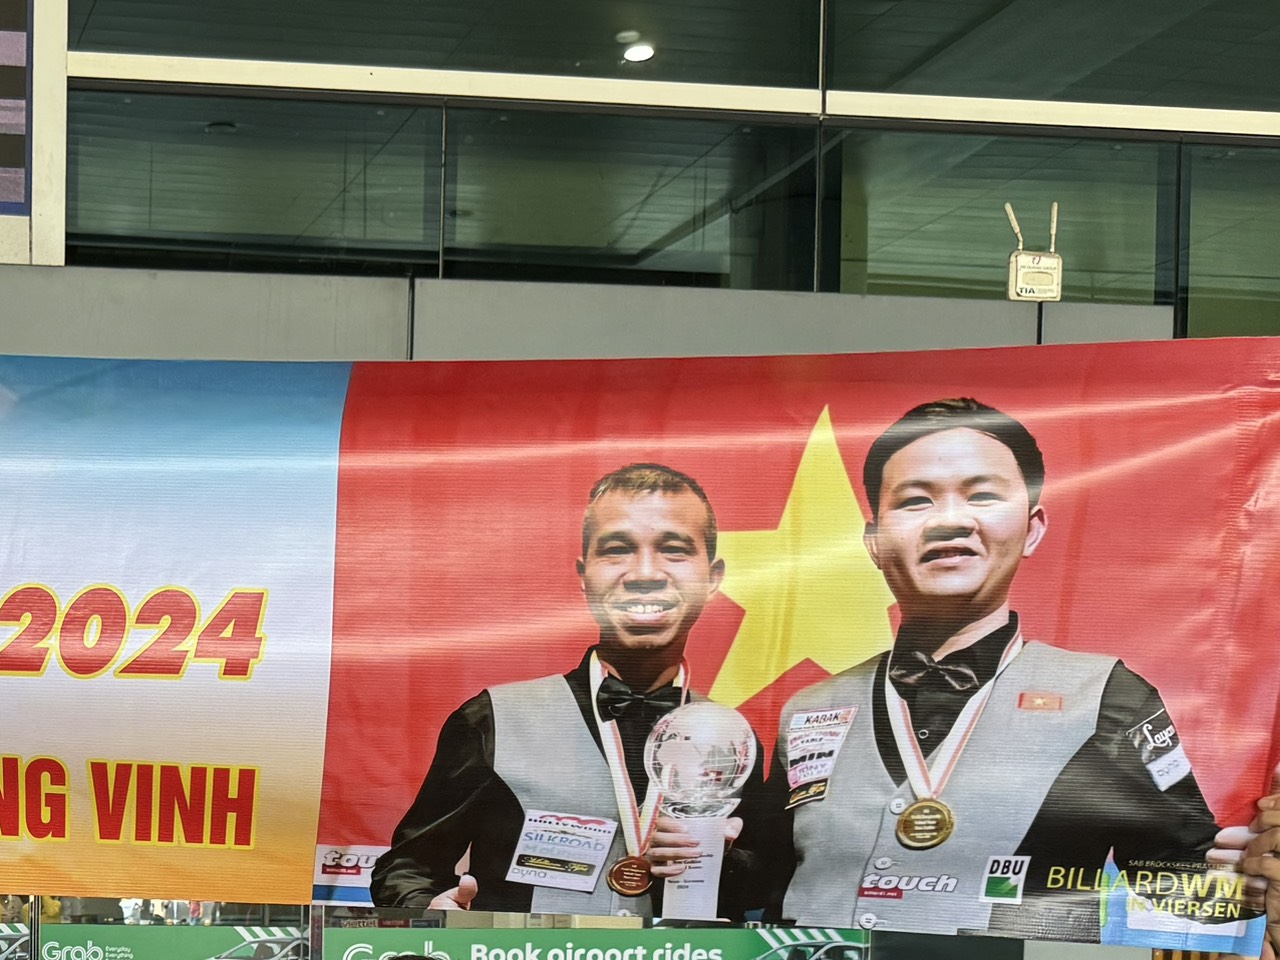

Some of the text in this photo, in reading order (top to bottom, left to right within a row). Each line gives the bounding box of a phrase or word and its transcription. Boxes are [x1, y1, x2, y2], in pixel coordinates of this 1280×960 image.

[87, 757, 261, 851] VINH
[988, 859, 1026, 876] DBU
[1151, 898, 1242, 919] VIERSEN
